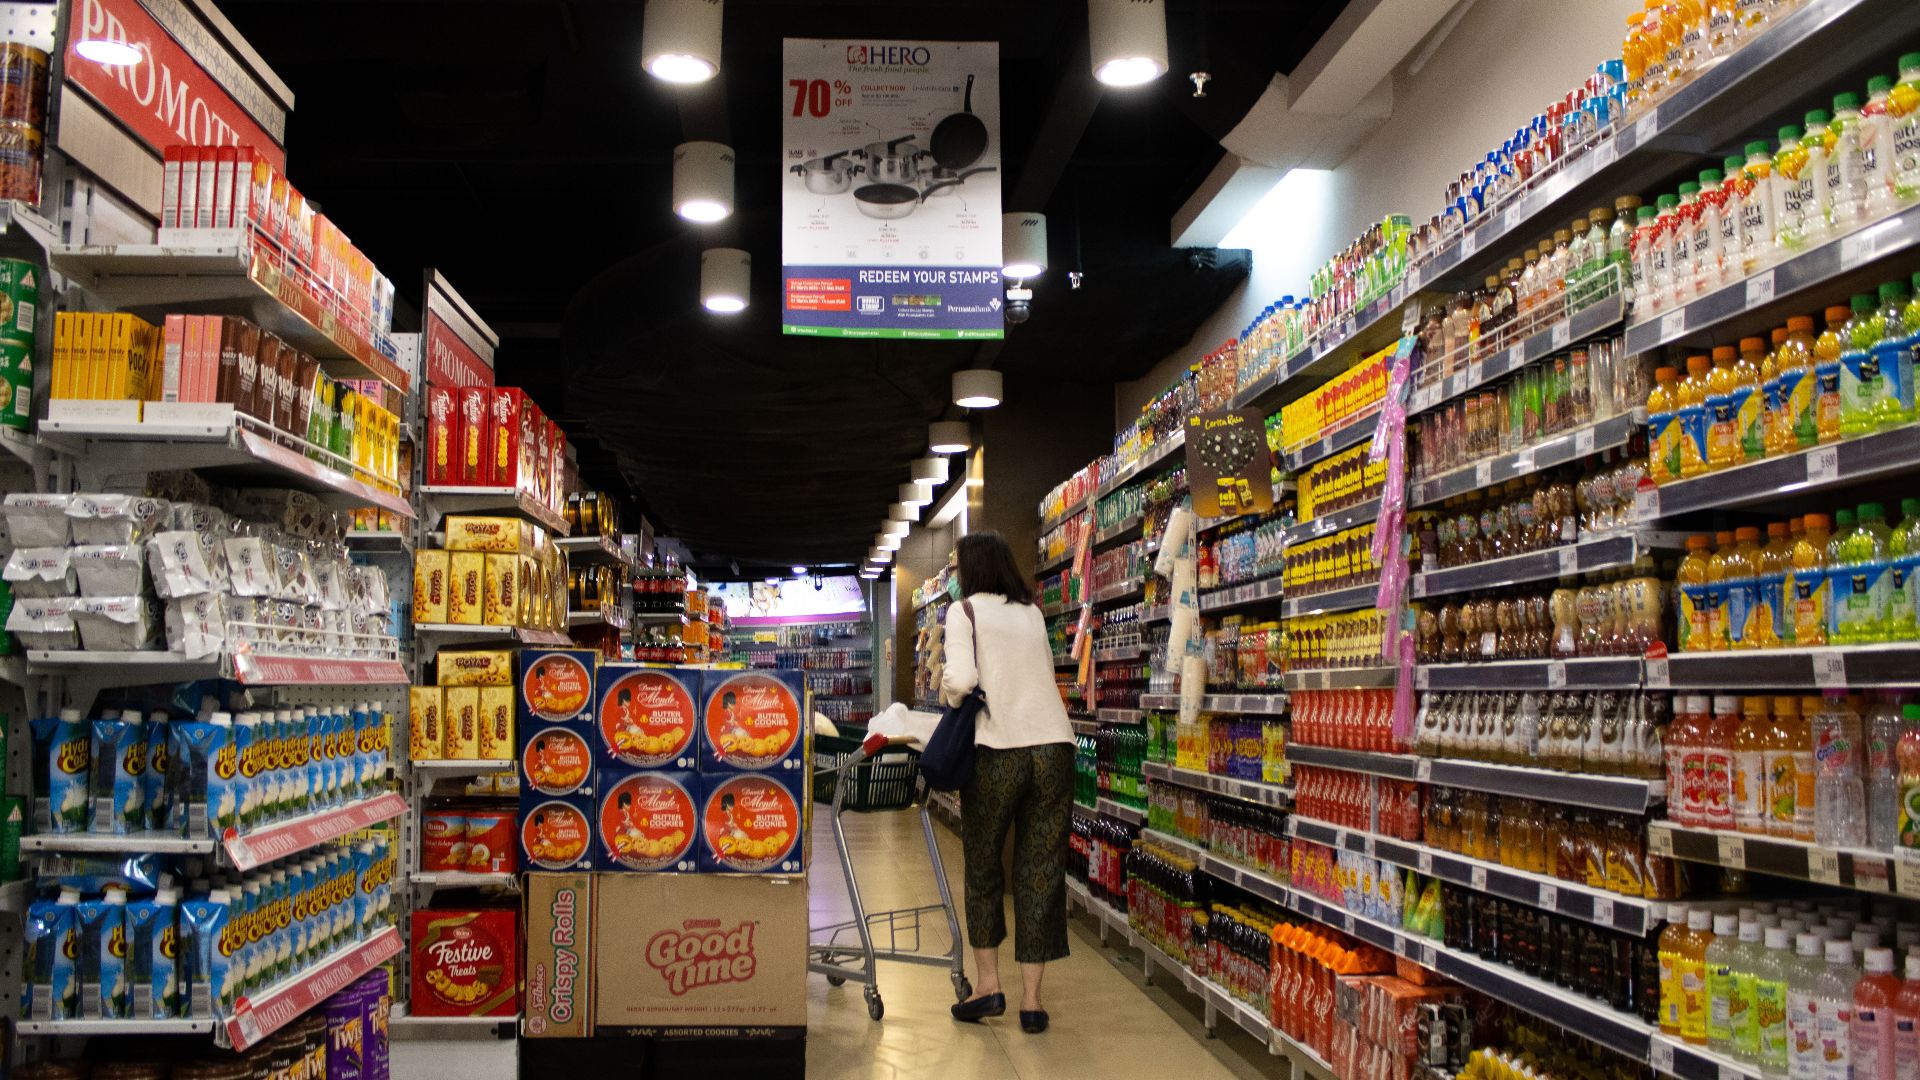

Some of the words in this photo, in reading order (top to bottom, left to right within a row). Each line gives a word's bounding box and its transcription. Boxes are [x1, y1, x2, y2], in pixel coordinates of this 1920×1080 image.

[870, 47, 931, 66] HERO
[859, 270, 910, 284] REDEEM
[913, 270, 946, 284] YOUR
[949, 271, 999, 285] STAMPS
[433, 571, 442, 604] ROYAL
[468, 571, 477, 604] ROYAL
[503, 572, 512, 606] ROYAL
[457, 658, 490, 667] ROYAL
[429, 706, 437, 738] ROYAL
[464, 706, 473, 738] ROYAL
[499, 706, 507, 738] ROYAL
[649, 717, 684, 725] COOKIES
[754, 719, 789, 727] COOKIES
[753, 820, 787, 828] COOKIES
[552, 889, 576, 946] Rolls
[428, 938, 493, 966] Festive
[648, 922, 755, 968] Good
[257, 995, 297, 1033] OMOTION
[307, 962, 354, 1000] PROMOTION
[360, 934, 398, 967] PROMOTION
[448, 965, 477, 978] Treats
[551, 948, 579, 1023] Crispy
[663, 954, 755, 995] Time
[328, 1024, 363, 1050] Twis
[664, 1028, 703, 1036] ASSORTED
[705, 1028, 739, 1036] COOKIES
